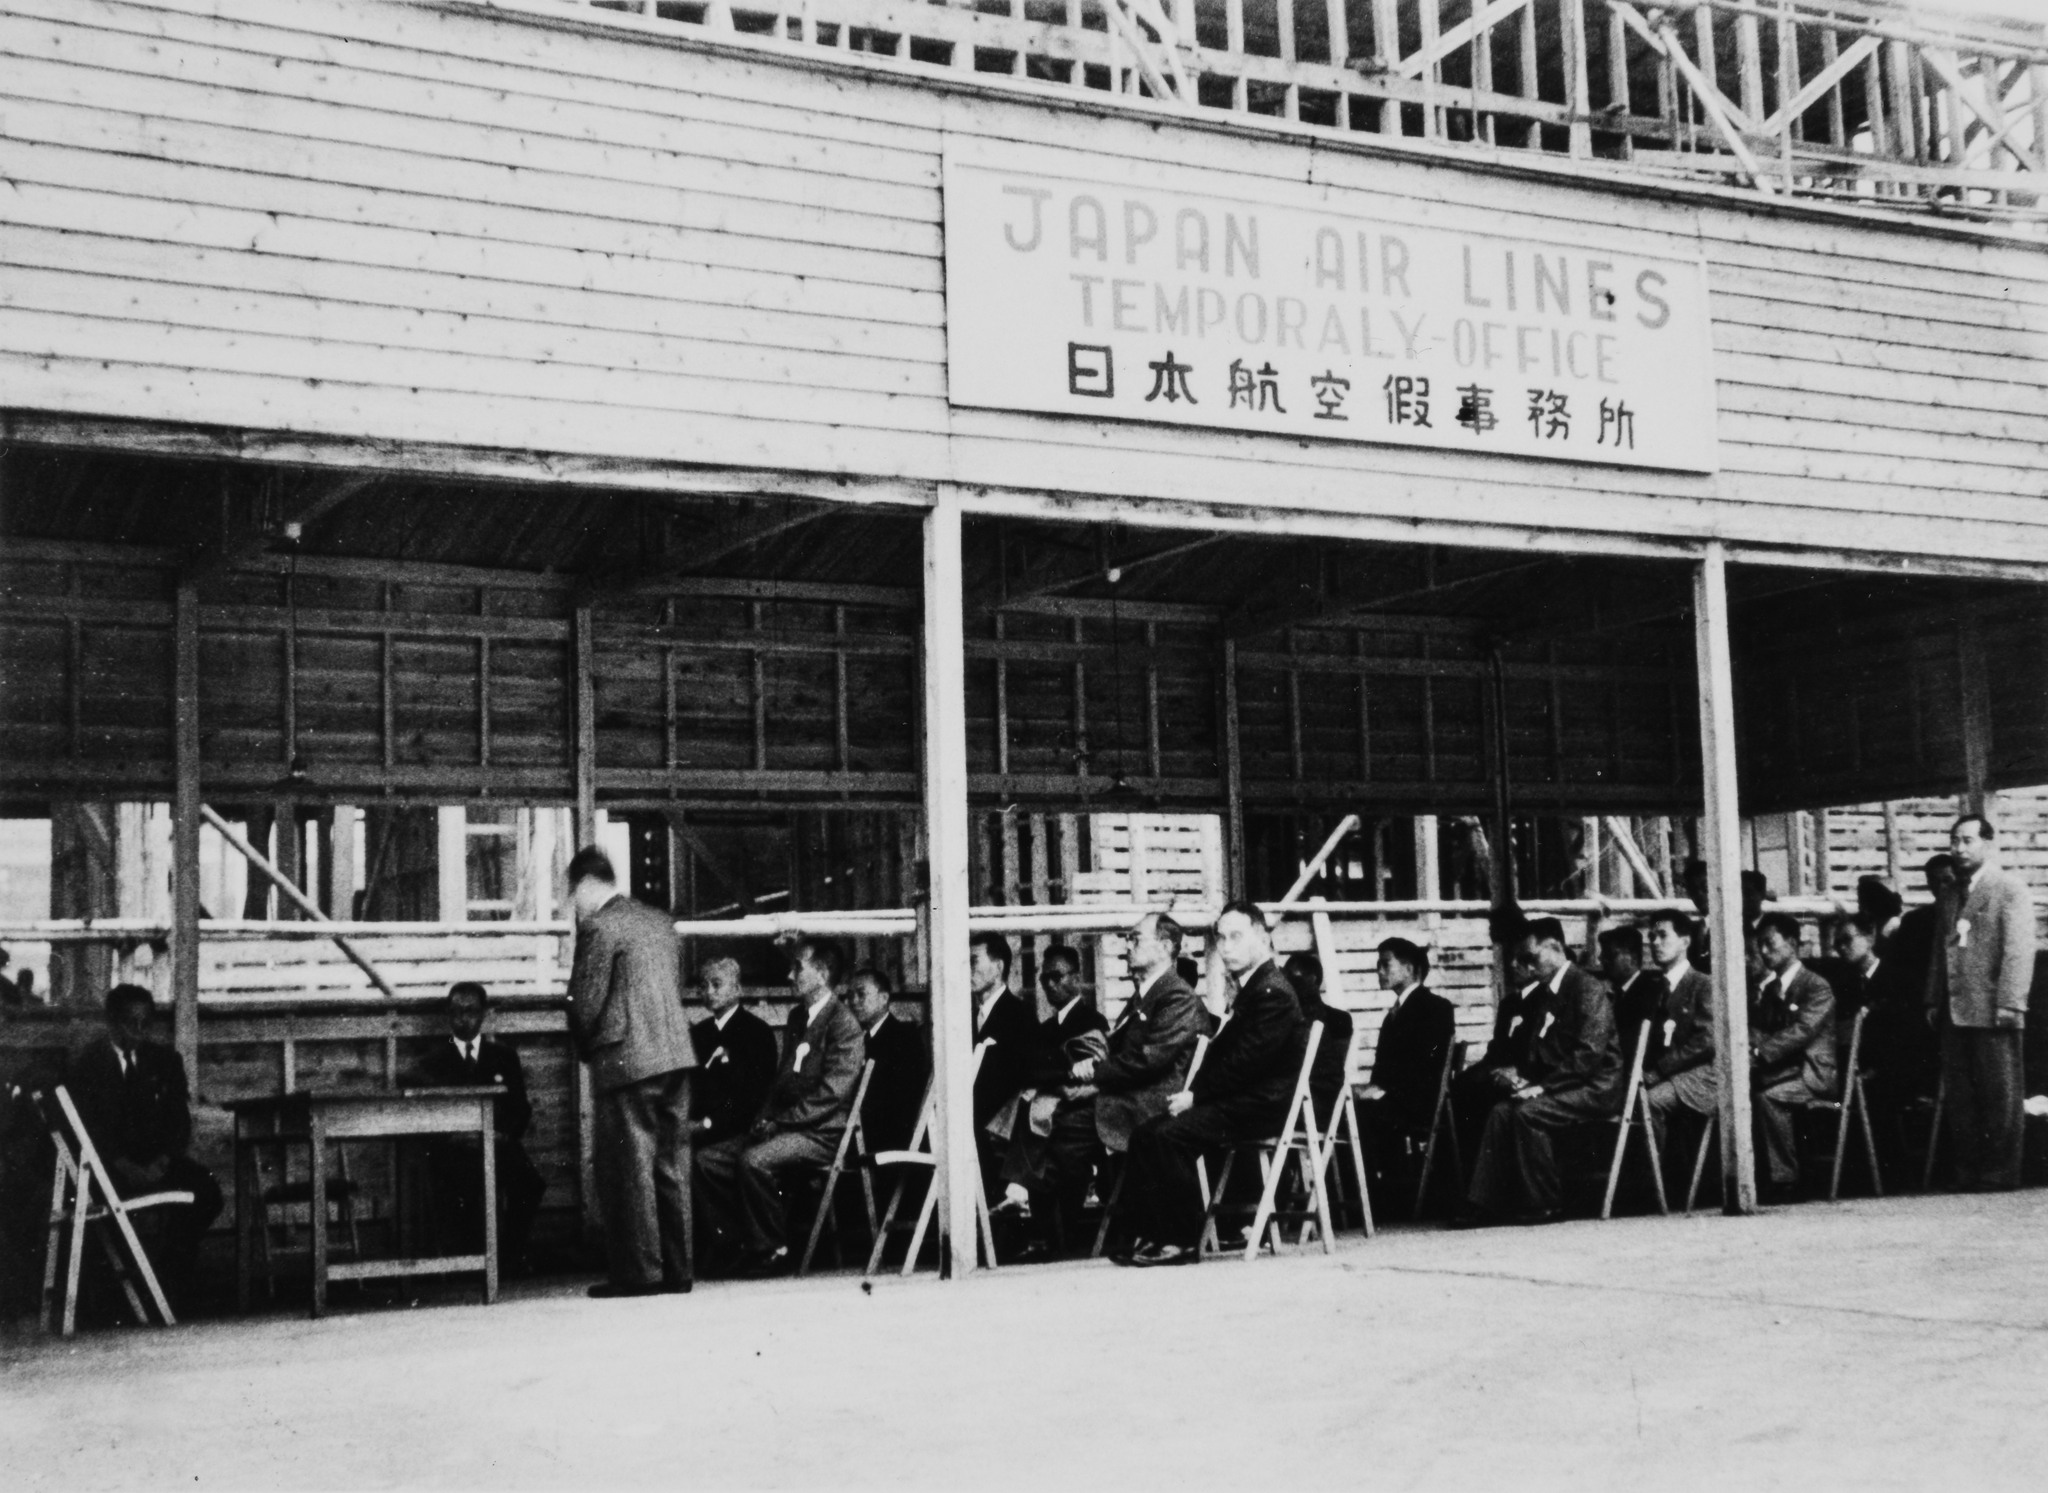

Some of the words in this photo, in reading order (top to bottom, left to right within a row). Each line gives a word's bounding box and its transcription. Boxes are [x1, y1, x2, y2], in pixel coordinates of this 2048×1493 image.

[1003, 185, 1260, 279] JAPAN
[1315, 225, 1412, 299] AIR
[1463, 245, 1671, 330] LINES
